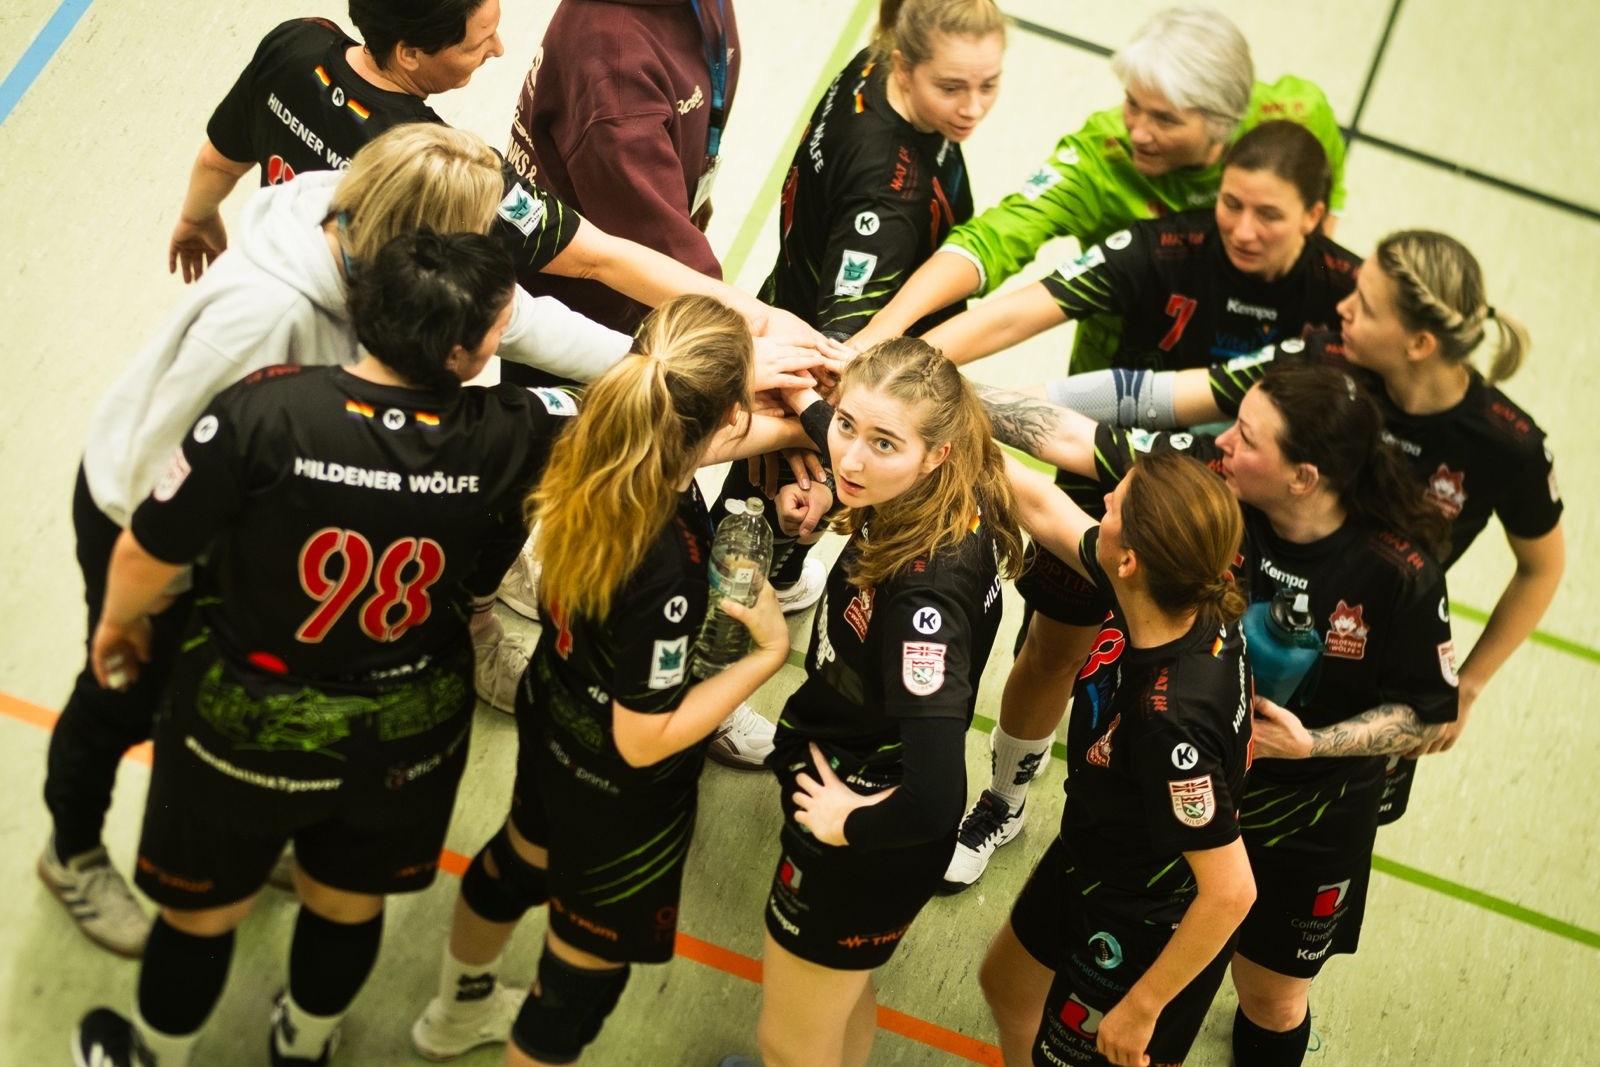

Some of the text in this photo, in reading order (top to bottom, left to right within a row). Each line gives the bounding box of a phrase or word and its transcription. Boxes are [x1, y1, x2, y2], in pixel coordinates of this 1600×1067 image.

[267, 92, 324, 156] HILDENER
[1158, 293, 1198, 352] 7
[1226, 298, 1278, 321] Kempa
[293, 457, 480, 494] HILDENER WÖLFE
[294, 526, 447, 645] 98
[1259, 557, 1309, 591] Kempa
